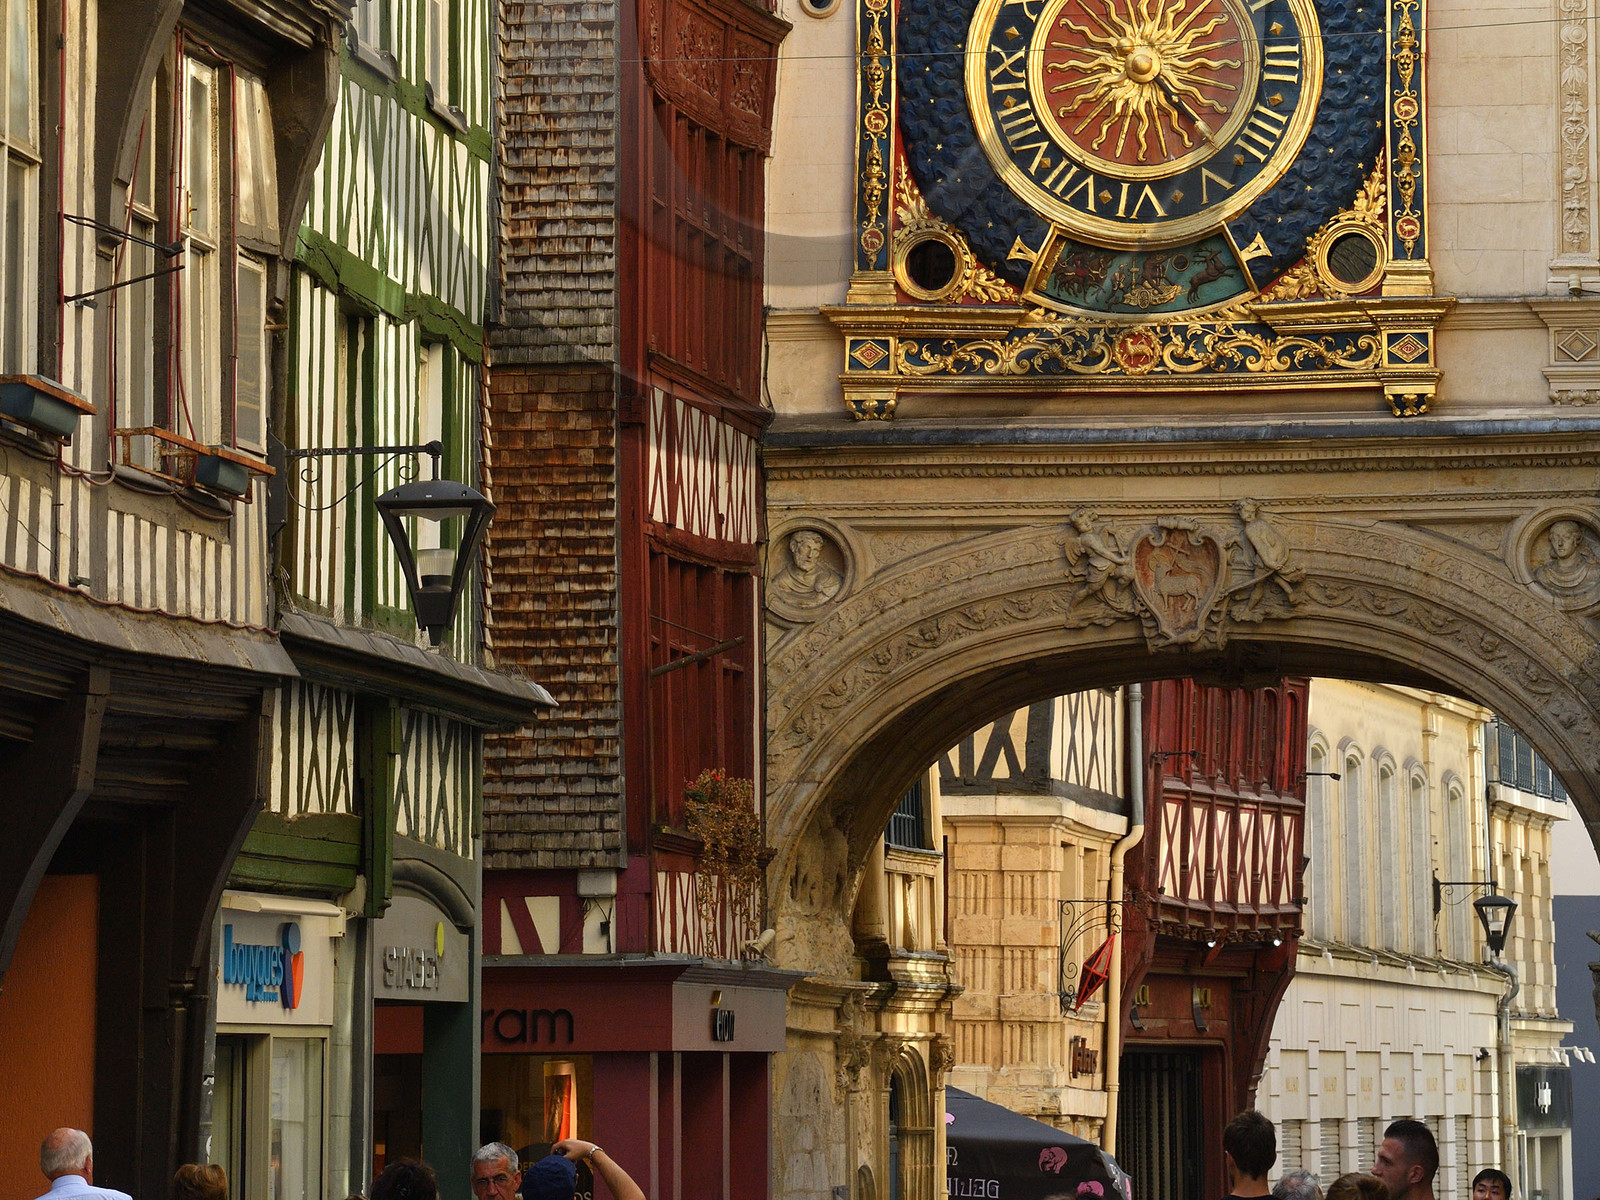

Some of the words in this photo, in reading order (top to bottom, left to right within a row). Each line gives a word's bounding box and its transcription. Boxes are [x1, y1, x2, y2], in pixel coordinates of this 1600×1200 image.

[990, 44, 1027, 93] IX
[1265, 45, 1299, 84] III
[1000, 101, 1050, 174] VIII
[1235, 105, 1288, 163] IIII
[1042, 156, 1097, 213] VII
[1116, 182, 1167, 219] VI
[1201, 166, 1235, 205] V
